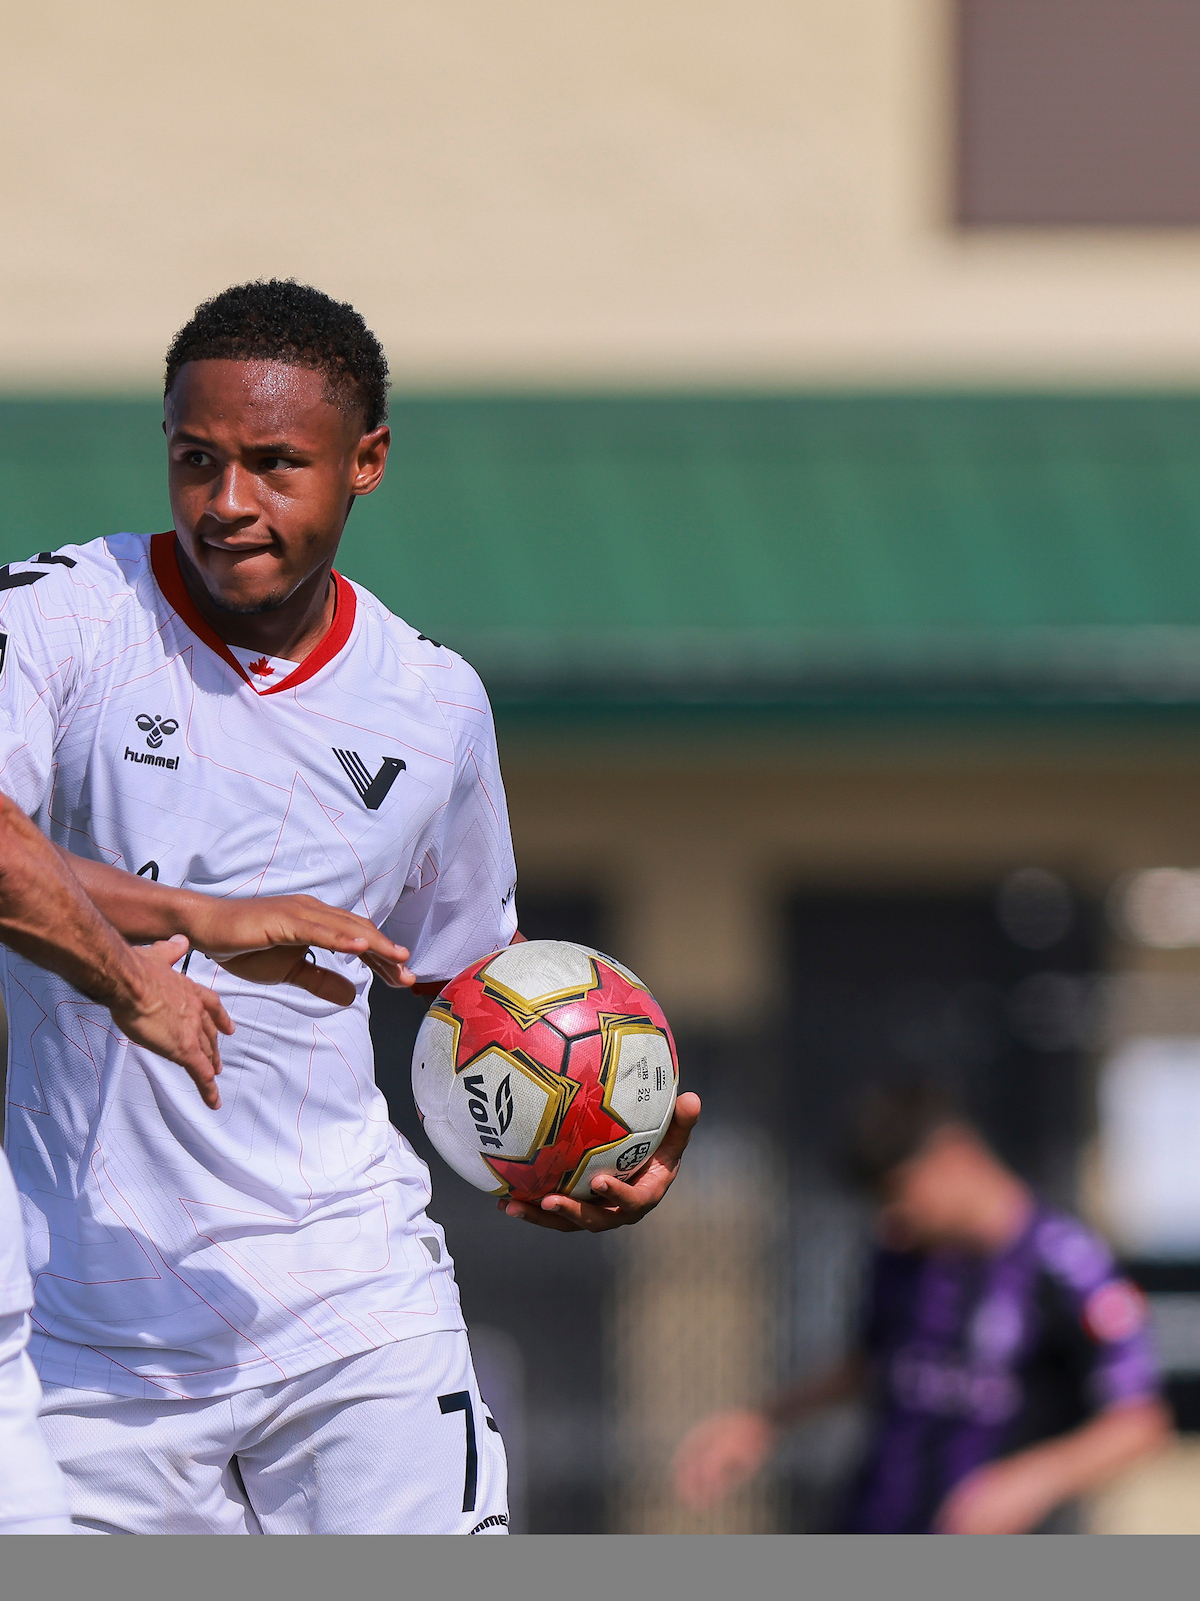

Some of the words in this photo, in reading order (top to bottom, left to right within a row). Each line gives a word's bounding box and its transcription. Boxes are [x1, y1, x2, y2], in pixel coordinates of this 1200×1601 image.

[124, 746, 180, 771] hummel
[463, 1074, 504, 1149] Voit
[437, 1390, 478, 1513] 7
